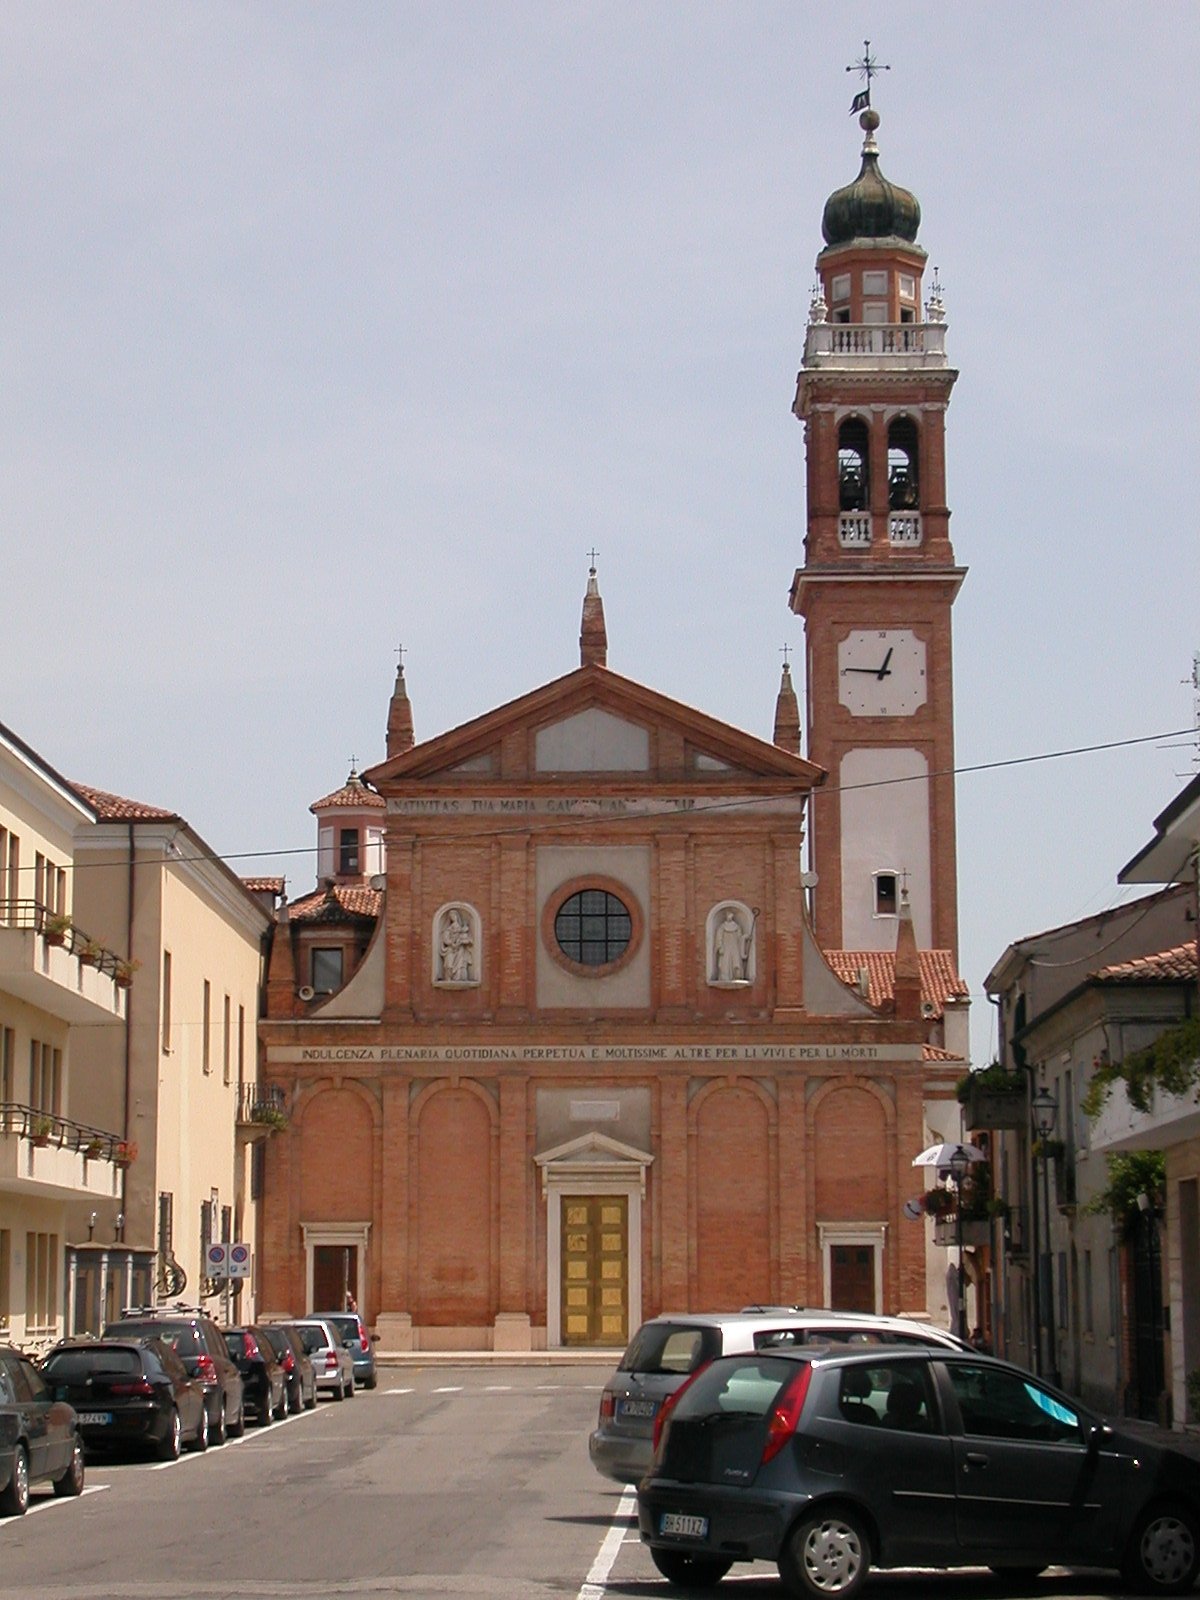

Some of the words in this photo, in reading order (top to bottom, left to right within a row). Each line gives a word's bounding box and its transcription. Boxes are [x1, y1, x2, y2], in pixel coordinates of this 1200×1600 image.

[500, 800, 536, 811] MARIA
[302, 1048, 375, 1059] INDULGENZA
[380, 1048, 440, 1059] PLENARIA
[445, 1048, 517, 1059] QUOTIDIANA
[523, 1048, 586, 1059] PERPETUA
[591, 1048, 600, 1058] E
[605, 1048, 668, 1058] MOLTISSIME
[674, 1048, 711, 1058] ALTRE
[716, 1048, 738, 1058] PER
[745, 1048, 756, 1058] LI
[761, 1048, 785, 1058] VIVI
[789, 1048, 796, 1058] E
[800, 1048, 820, 1058] PER
[826, 1048, 836, 1058] LI
[841, 1048, 878, 1058] MORTI
